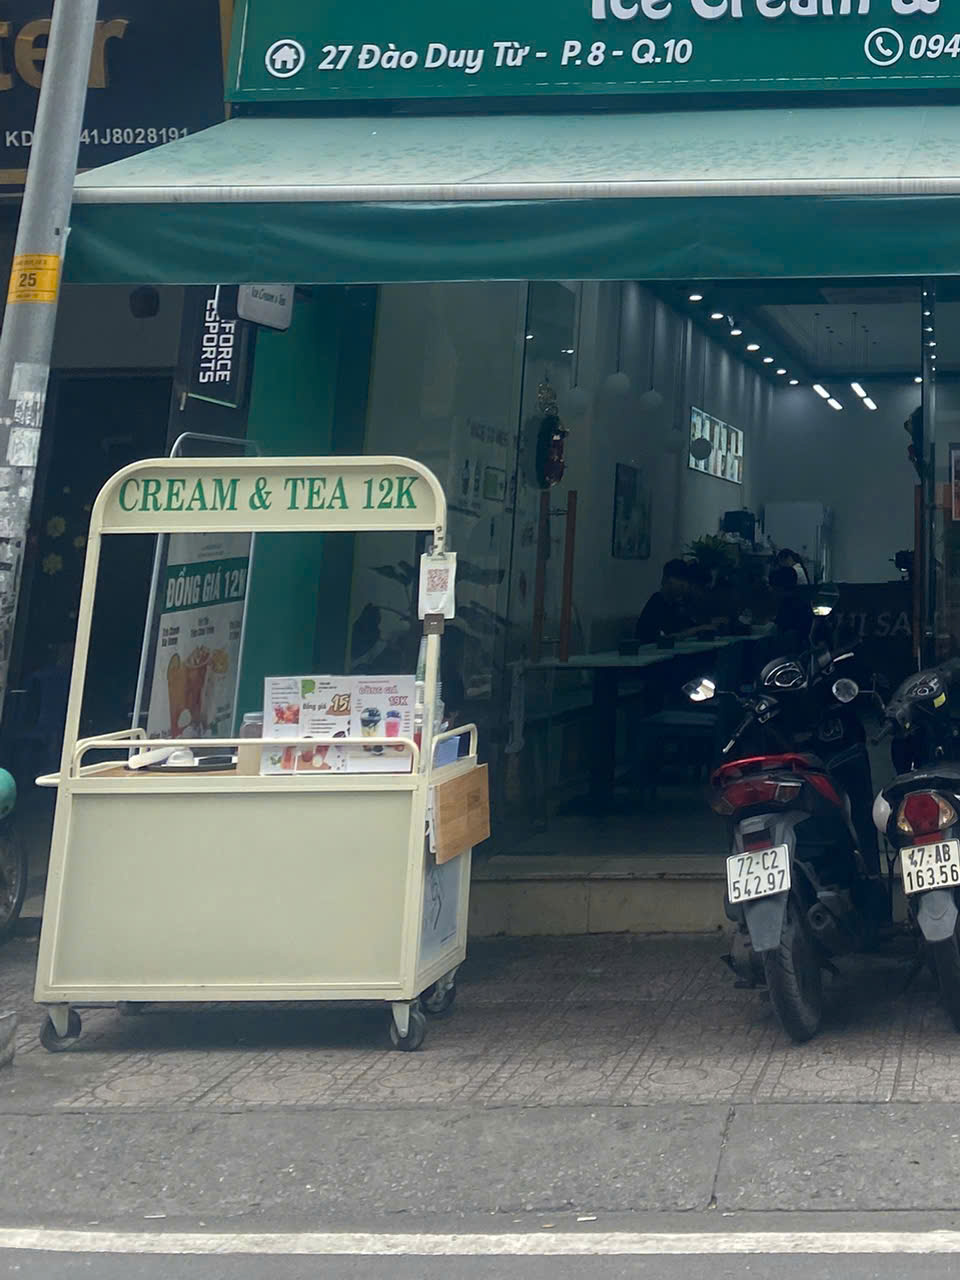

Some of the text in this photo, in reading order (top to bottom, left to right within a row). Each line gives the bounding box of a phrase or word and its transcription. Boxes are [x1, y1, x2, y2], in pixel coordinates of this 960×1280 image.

[318, 44, 353, 71] 27
[357, 42, 418, 71] Đào
[424, 43, 484, 75] Duy
[493, 39, 530, 68] Từ
[631, 39, 693, 66] Q.10
[18, 272, 37, 288] 25
[118, 476, 420, 512] CREAM & TEA 12K
[202, 566, 222, 602] GIÁ
[388, 695, 408, 706] 19K
[737, 850, 779, 878] 72-C2
[907, 864, 959, 890] 163.56
[733, 869, 785, 900] 542.97
